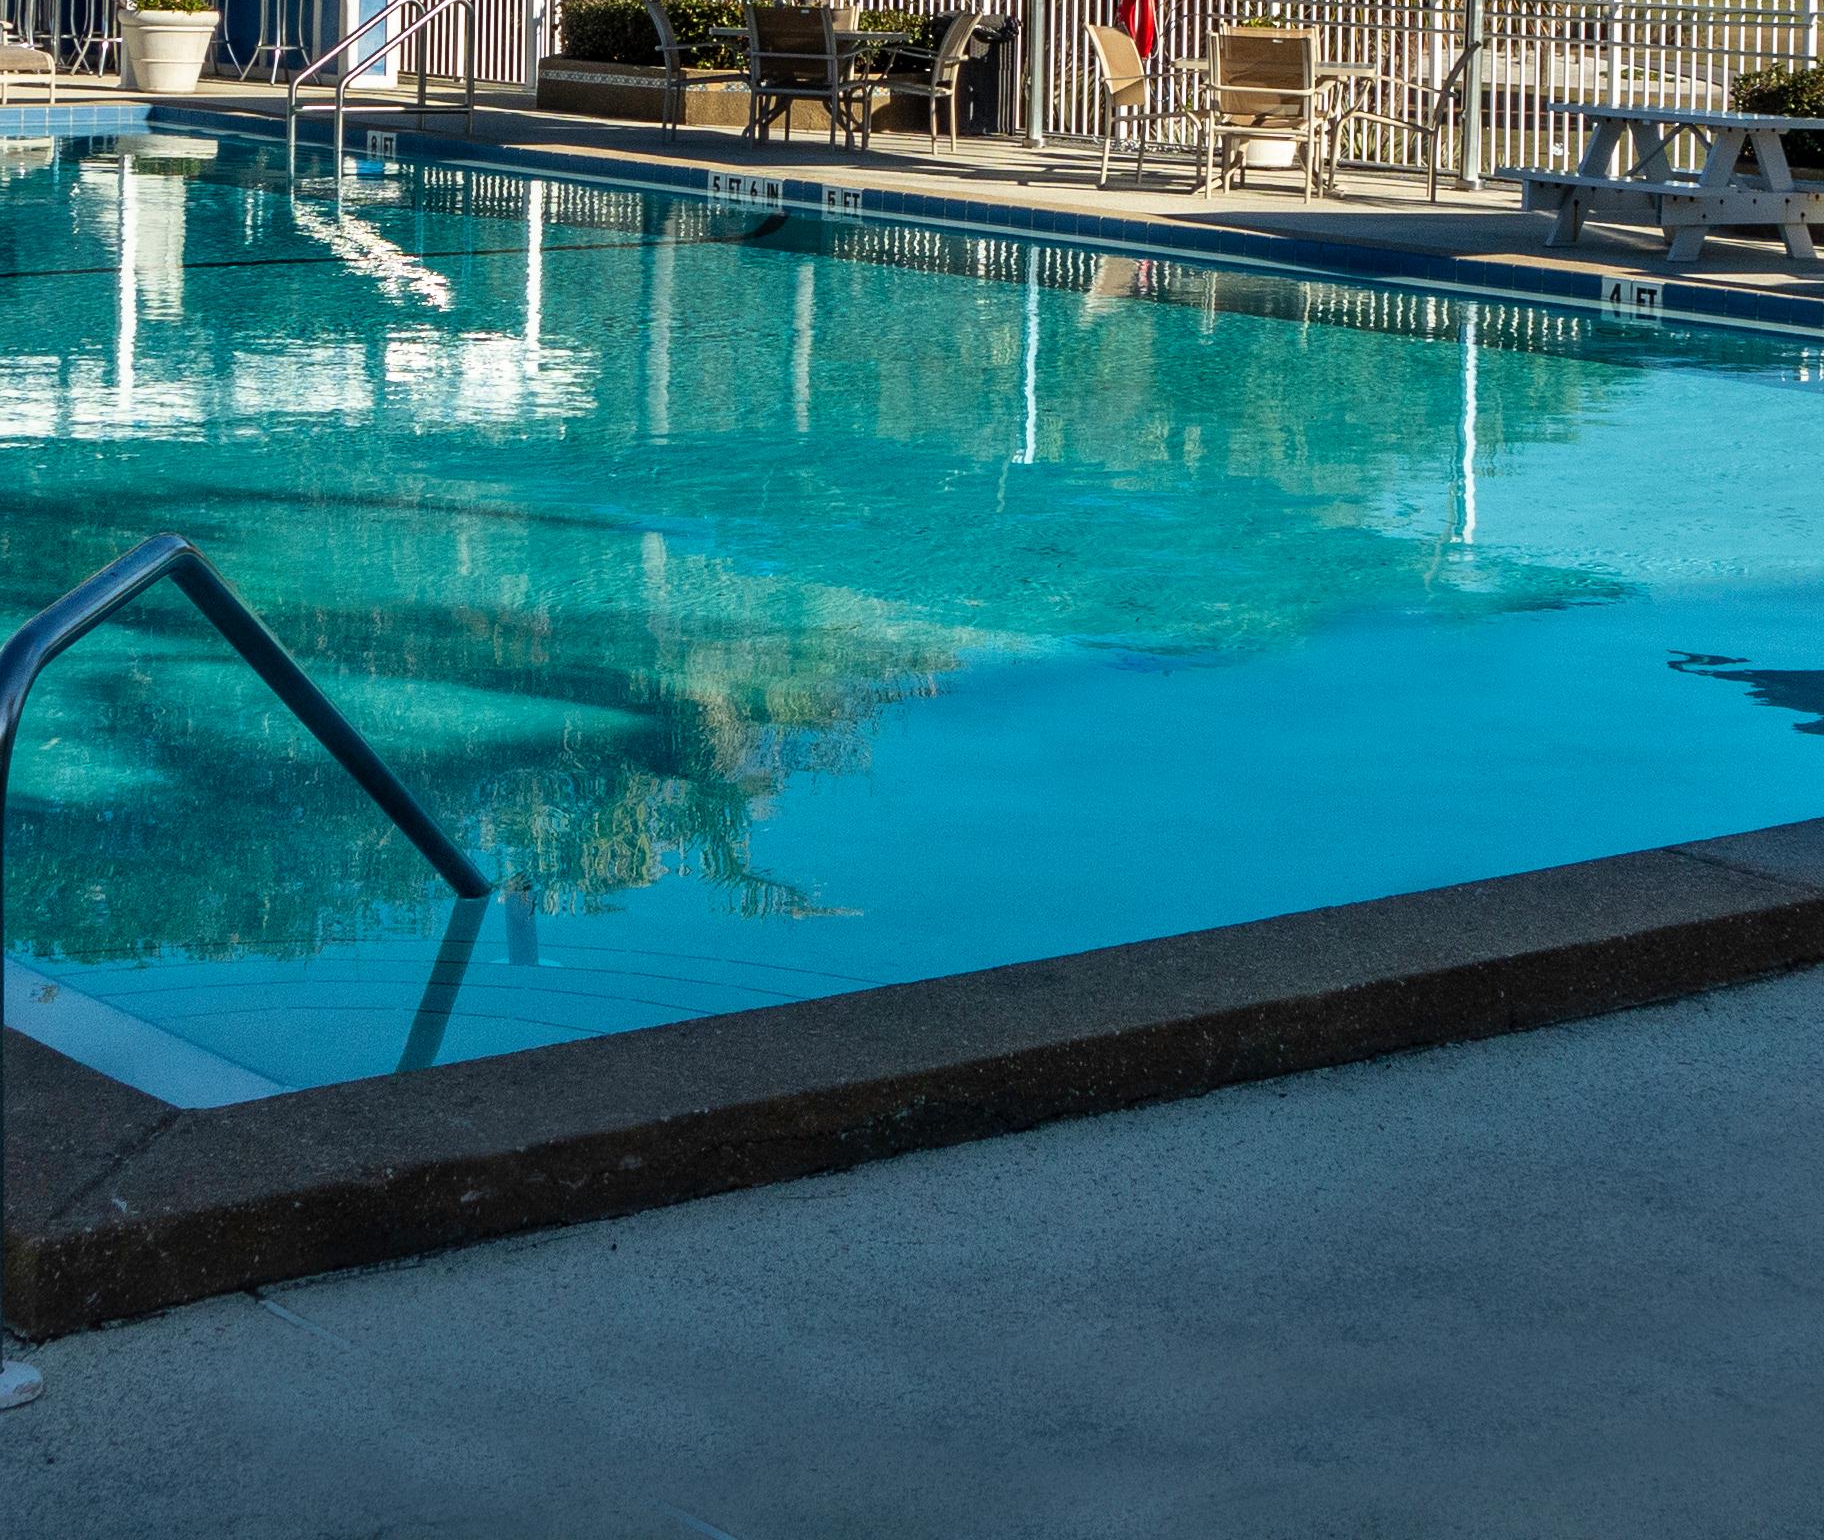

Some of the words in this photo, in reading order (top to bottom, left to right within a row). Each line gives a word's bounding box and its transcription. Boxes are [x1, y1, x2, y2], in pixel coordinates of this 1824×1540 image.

[713, 176, 721, 192] 5
[728, 177, 742, 194] FT
[750, 180, 758, 197] 6
[766, 182, 779, 198] IN
[828, 191, 836, 206] 5
[843, 192, 860, 208] FT
[1609, 283, 1622, 304] 4
[1636, 287, 1658, 308] FT
